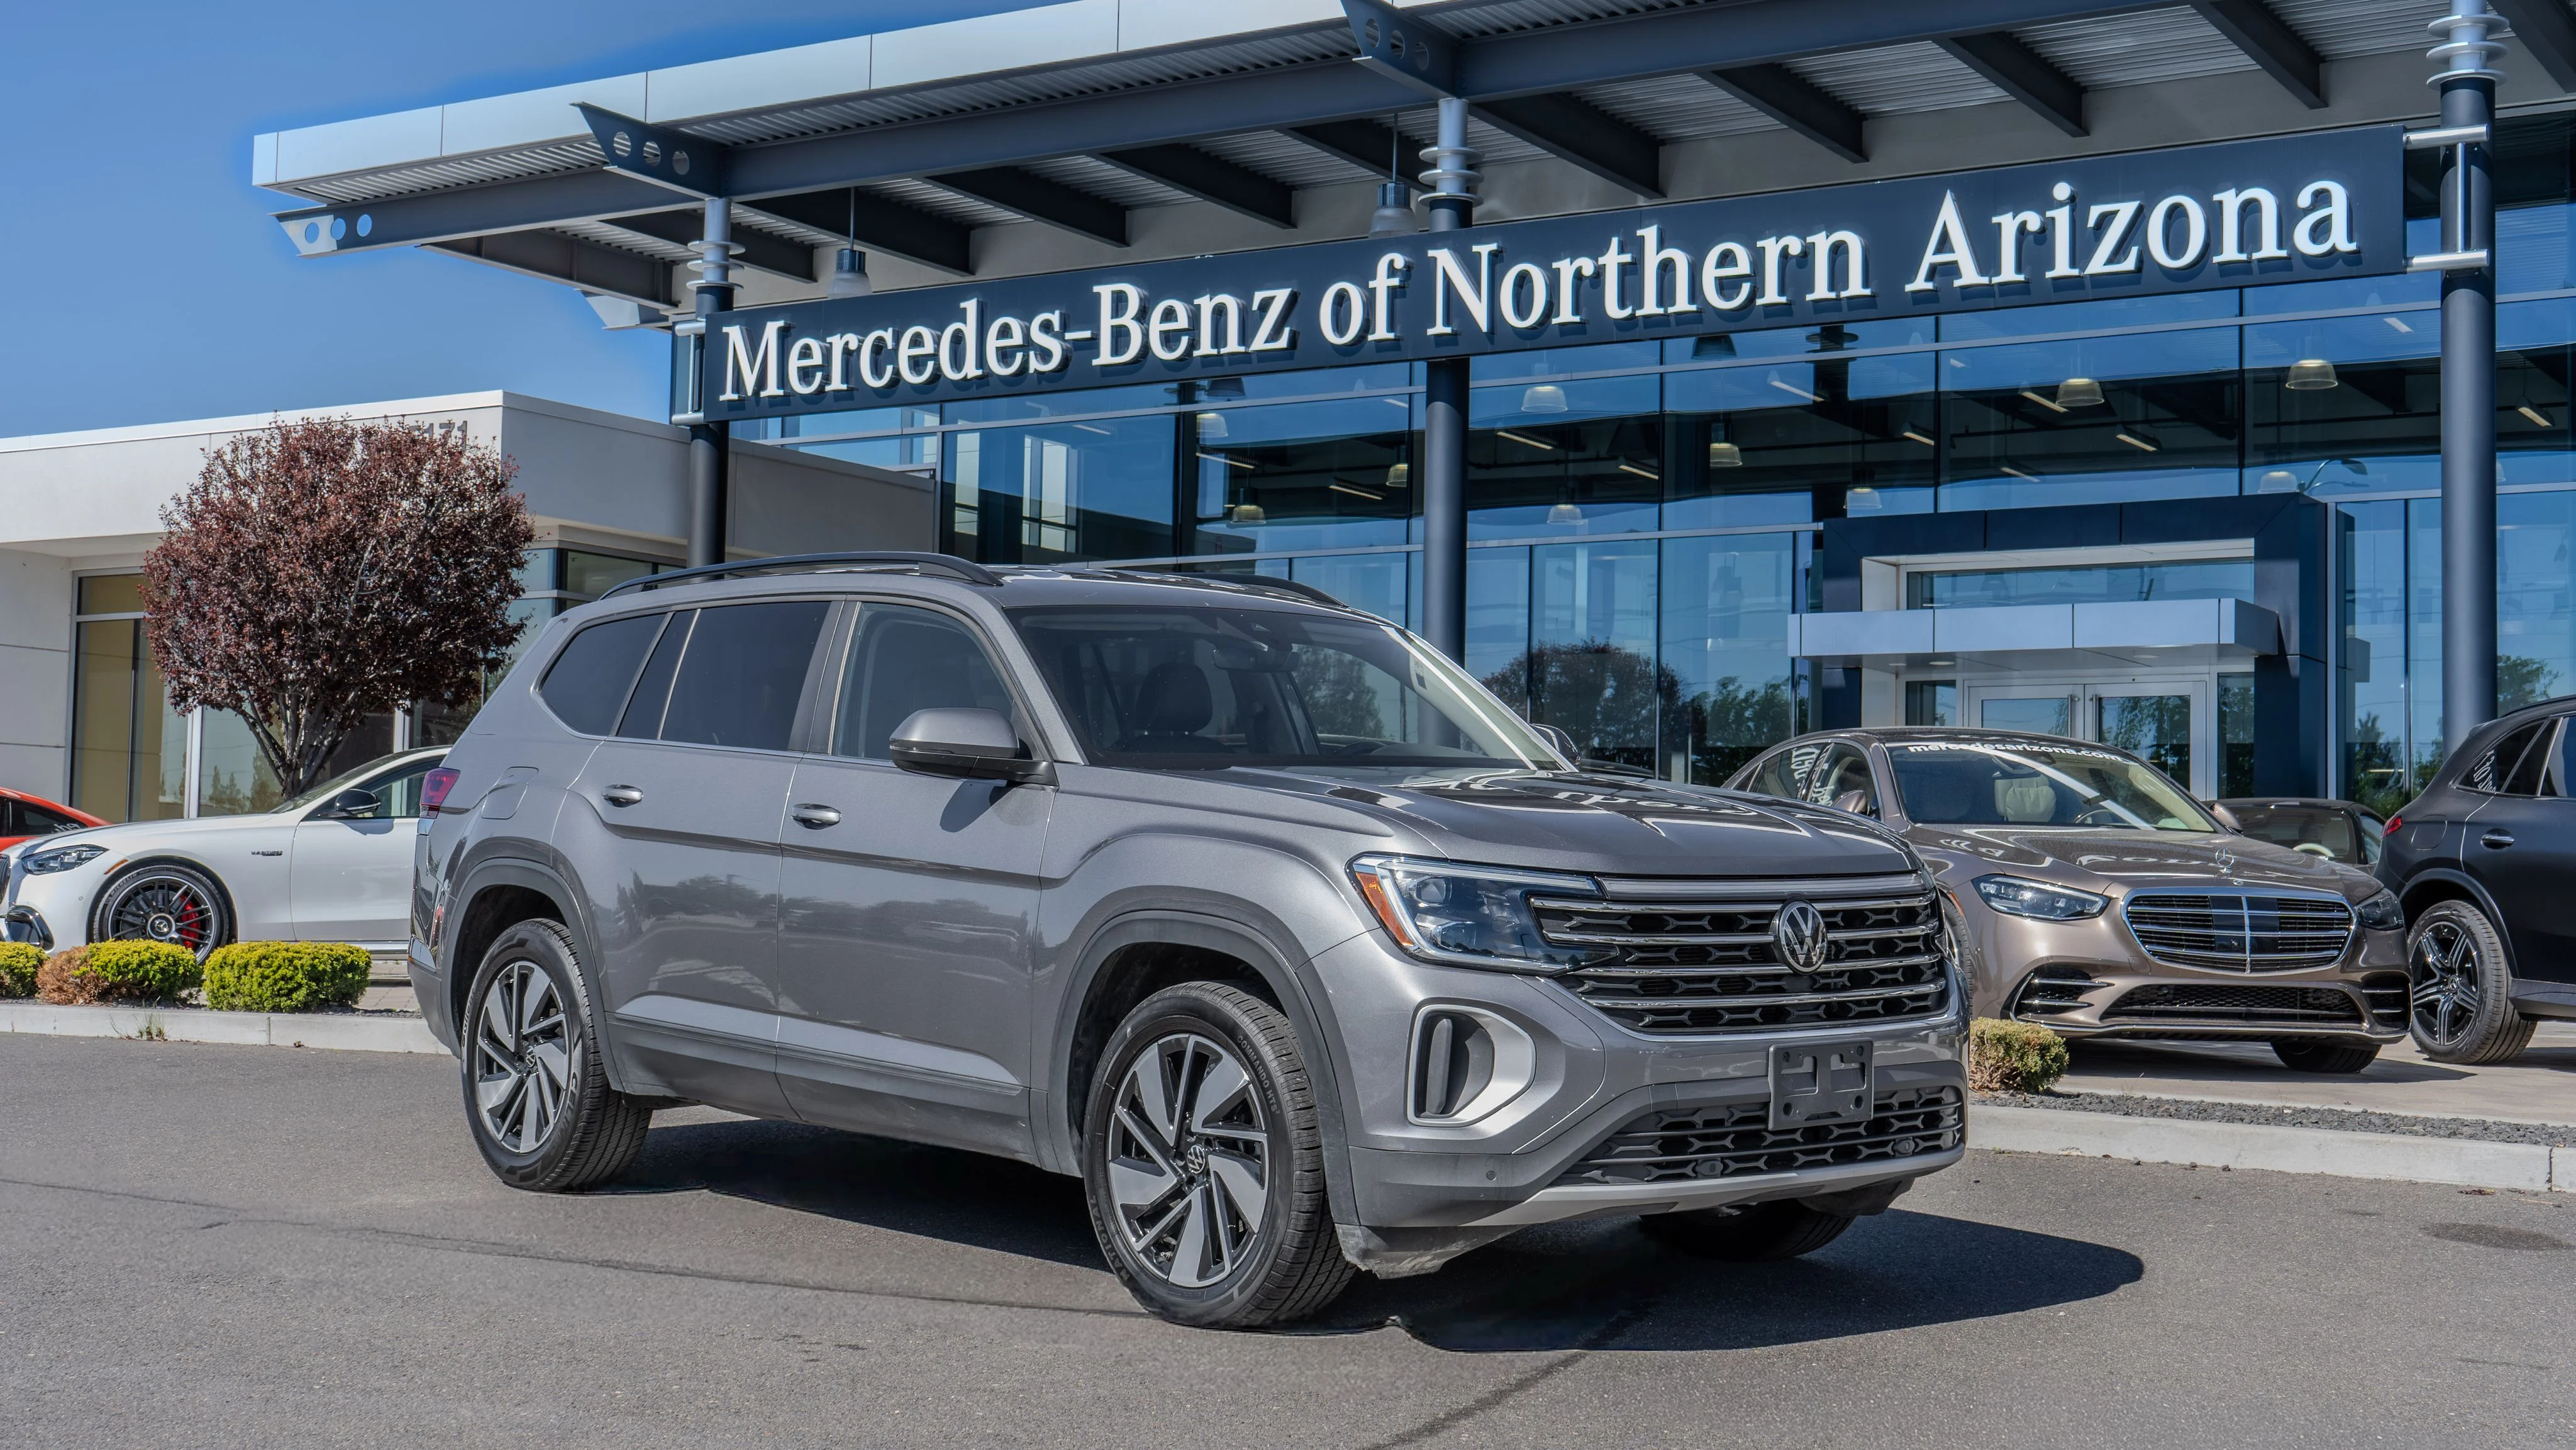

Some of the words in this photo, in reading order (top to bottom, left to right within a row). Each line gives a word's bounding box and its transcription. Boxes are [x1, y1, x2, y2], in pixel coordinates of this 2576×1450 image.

[719, 283, 1296, 401] Mercedes-Benz
[1319, 252, 1407, 345] of
[1426, 223, 1873, 336] Northern
[1904, 180, 2358, 293] Arizona
[1237, 1035, 1269, 1088] COMMANDO
[1090, 1195, 1130, 1281] NATIONAL
